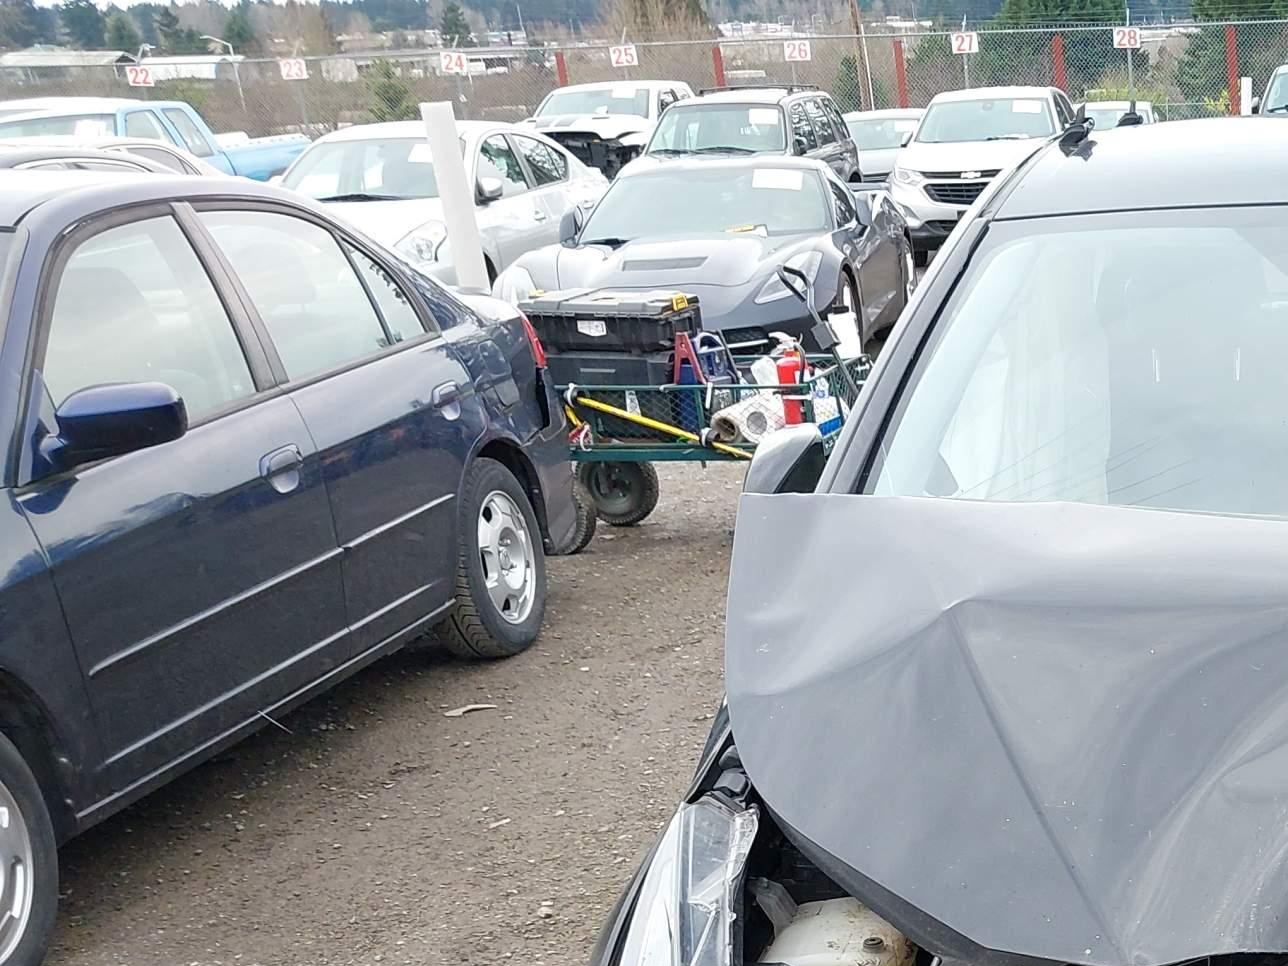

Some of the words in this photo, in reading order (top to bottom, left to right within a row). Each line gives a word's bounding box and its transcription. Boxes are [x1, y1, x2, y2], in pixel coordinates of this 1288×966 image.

[955, 34, 975, 51] 27
[1116, 29, 1138, 46] 28
[613, 47, 635, 65] 25
[787, 42, 808, 59] 26
[285, 60, 305, 78] 23
[443, 54, 465, 71] 24
[129, 68, 150, 85] 22
